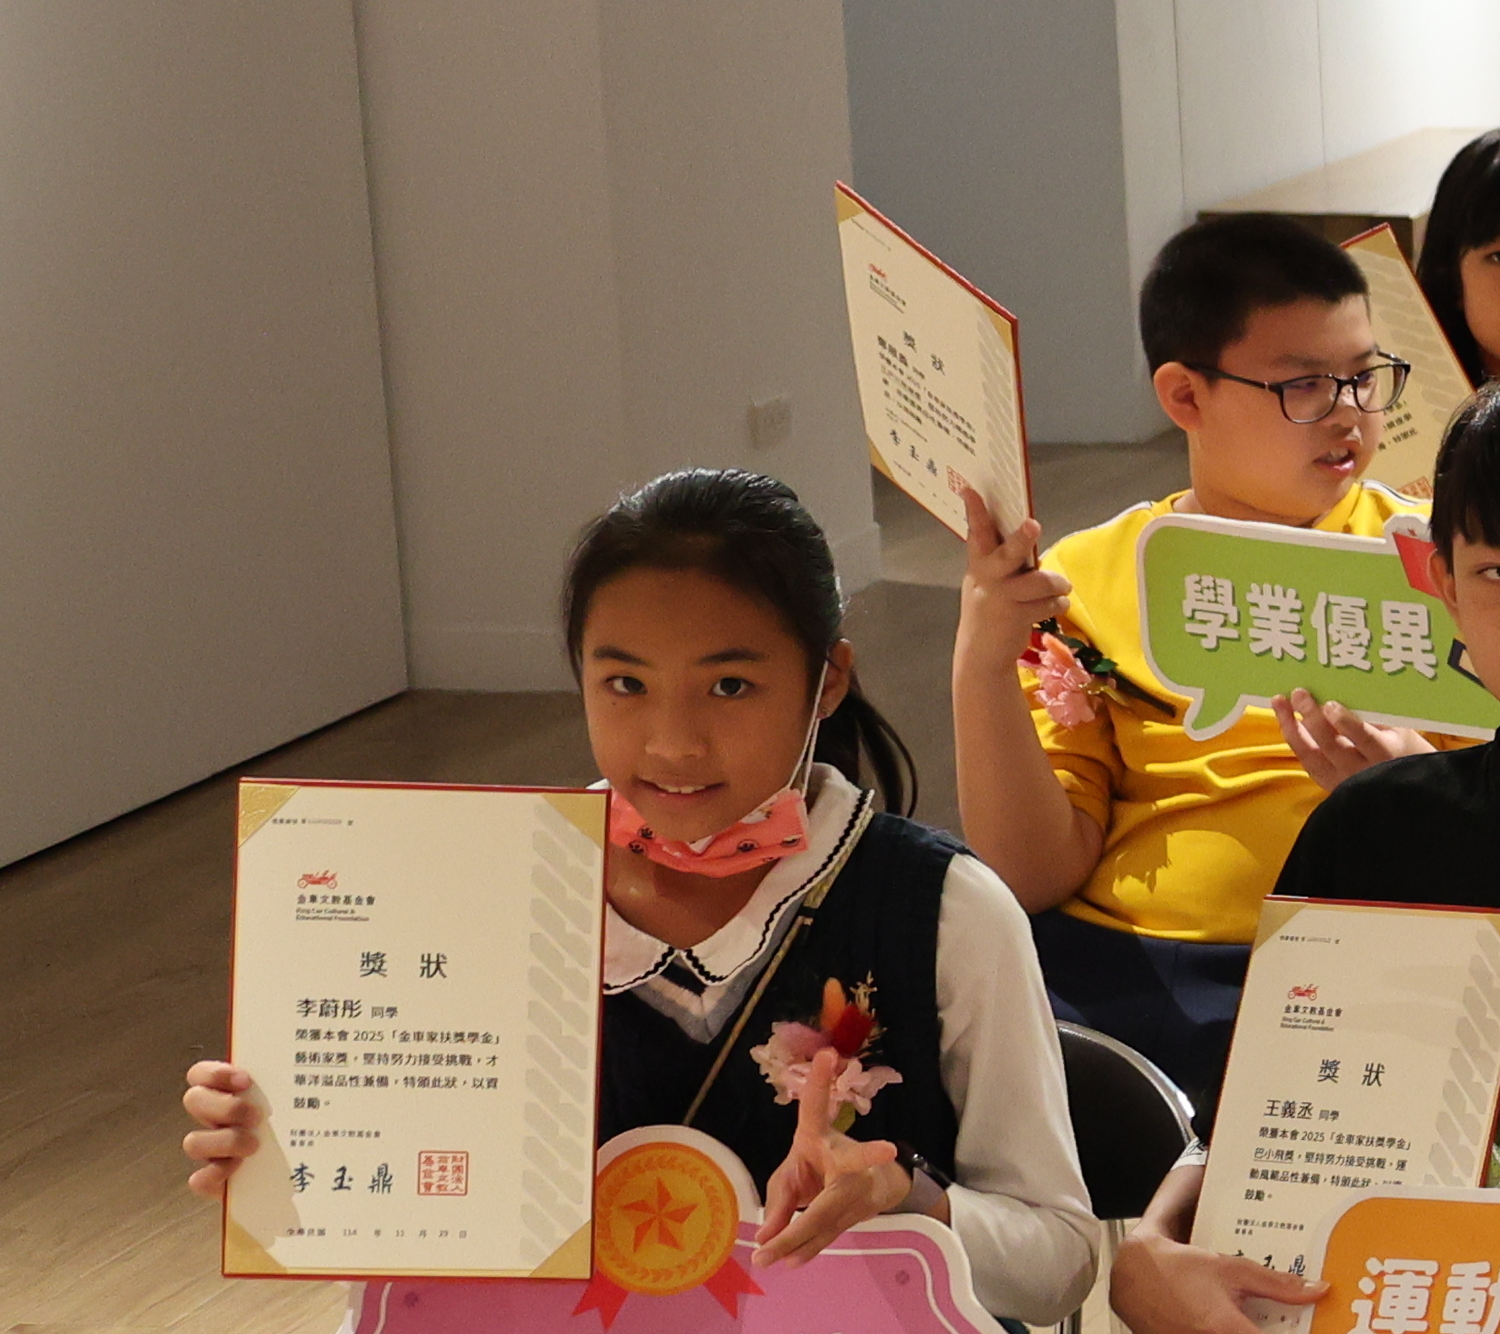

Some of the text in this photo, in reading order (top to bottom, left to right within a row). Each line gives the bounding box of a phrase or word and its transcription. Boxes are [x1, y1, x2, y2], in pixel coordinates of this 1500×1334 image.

[1182, 574, 1438, 679] 學業優異
[296, 998, 398, 1019] 李蔚彤 同學
[1264, 1099, 1339, 1121] 王義丞 同學
[1249, 1169, 1402, 1190] 動風範品性兼備，特頒此狀，
